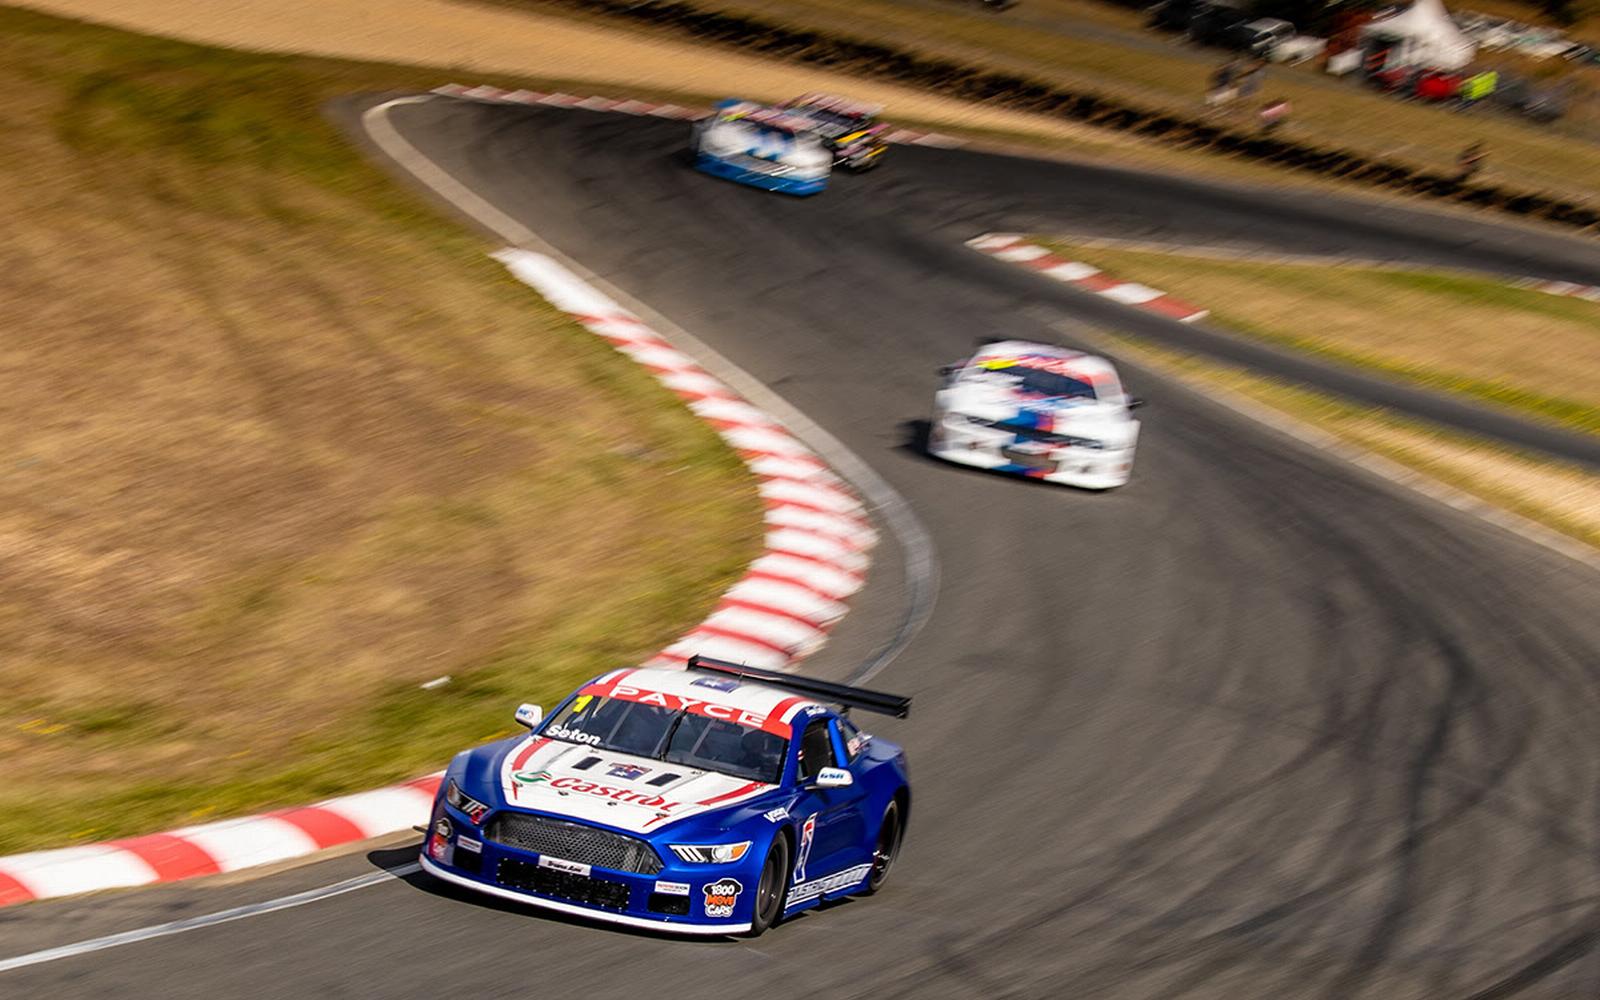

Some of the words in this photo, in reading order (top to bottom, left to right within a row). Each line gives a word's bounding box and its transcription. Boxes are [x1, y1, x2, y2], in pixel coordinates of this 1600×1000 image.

[572, 695, 593, 713] 1
[609, 686, 767, 728] PAYCE
[546, 725, 601, 746] Seton
[550, 777, 680, 812] Castrol
[711, 885, 735, 896] 1800
[707, 904, 732, 915] CARS
